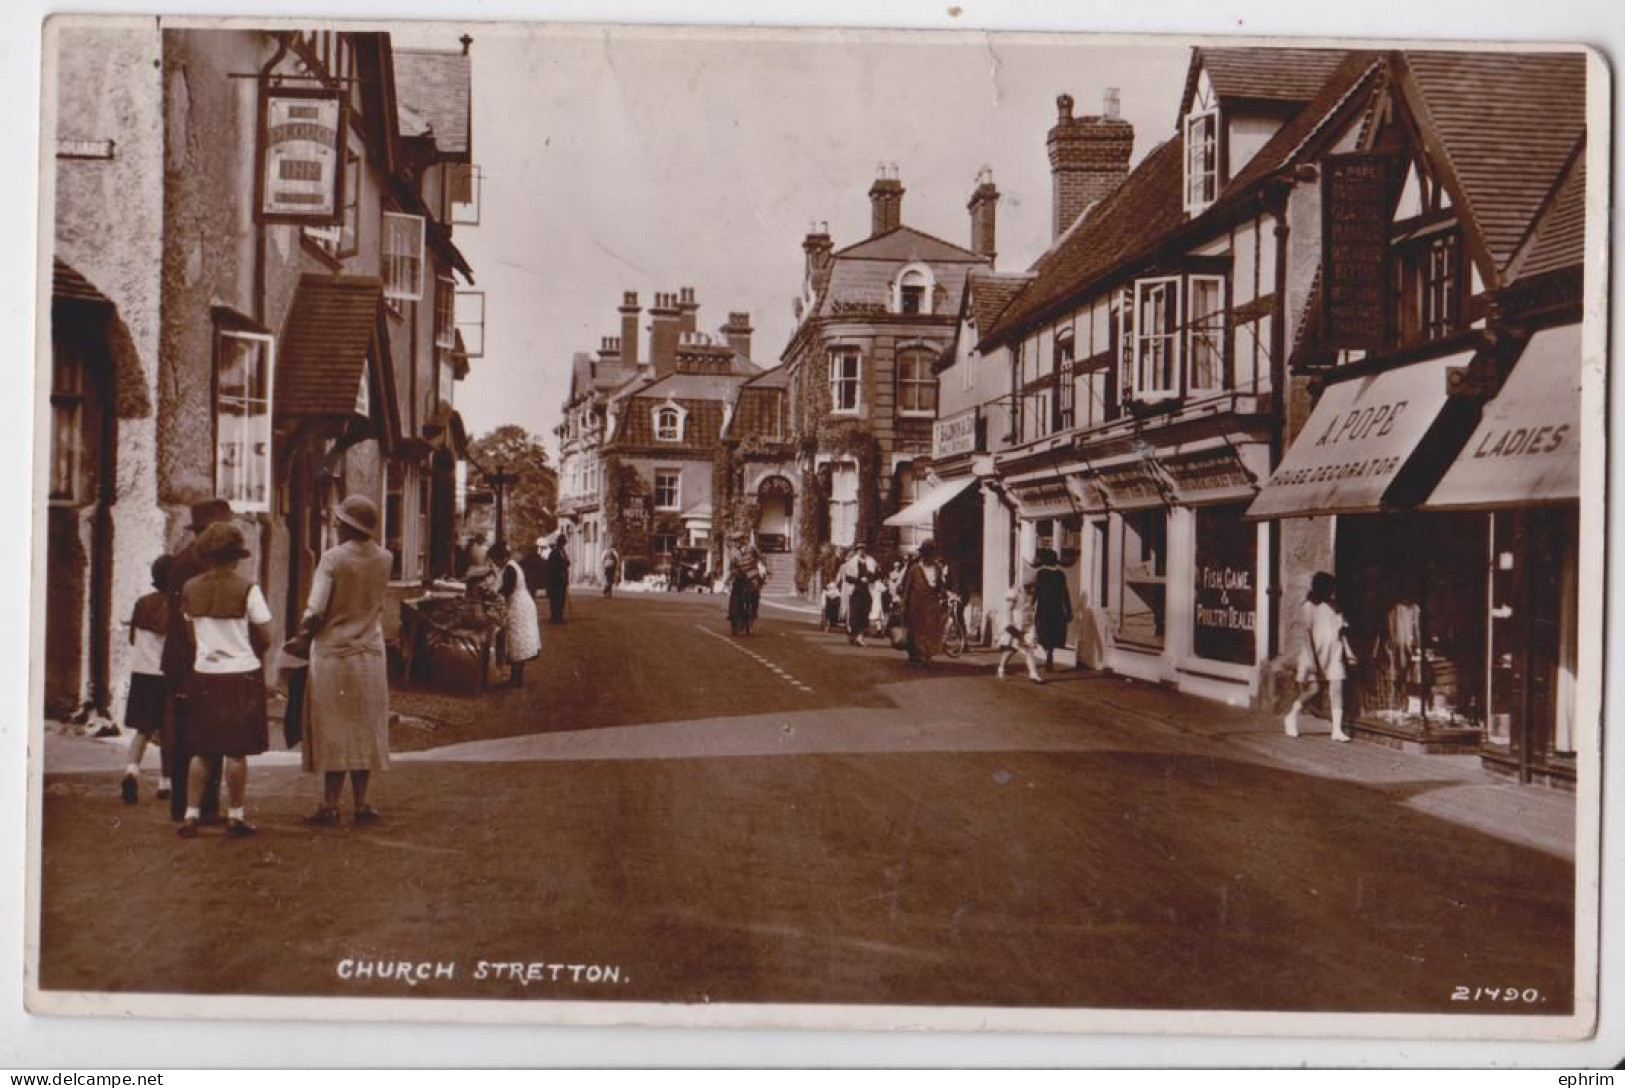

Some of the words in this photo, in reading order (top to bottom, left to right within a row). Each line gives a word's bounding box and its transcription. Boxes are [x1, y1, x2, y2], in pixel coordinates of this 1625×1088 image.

[284, 161, 319, 180] INN
[1473, 424, 1569, 458] LADIES
[1309, 456, 1400, 482] DECORATOR
[1221, 590, 1229, 605] &
[1197, 603, 1227, 628] POULTRY
